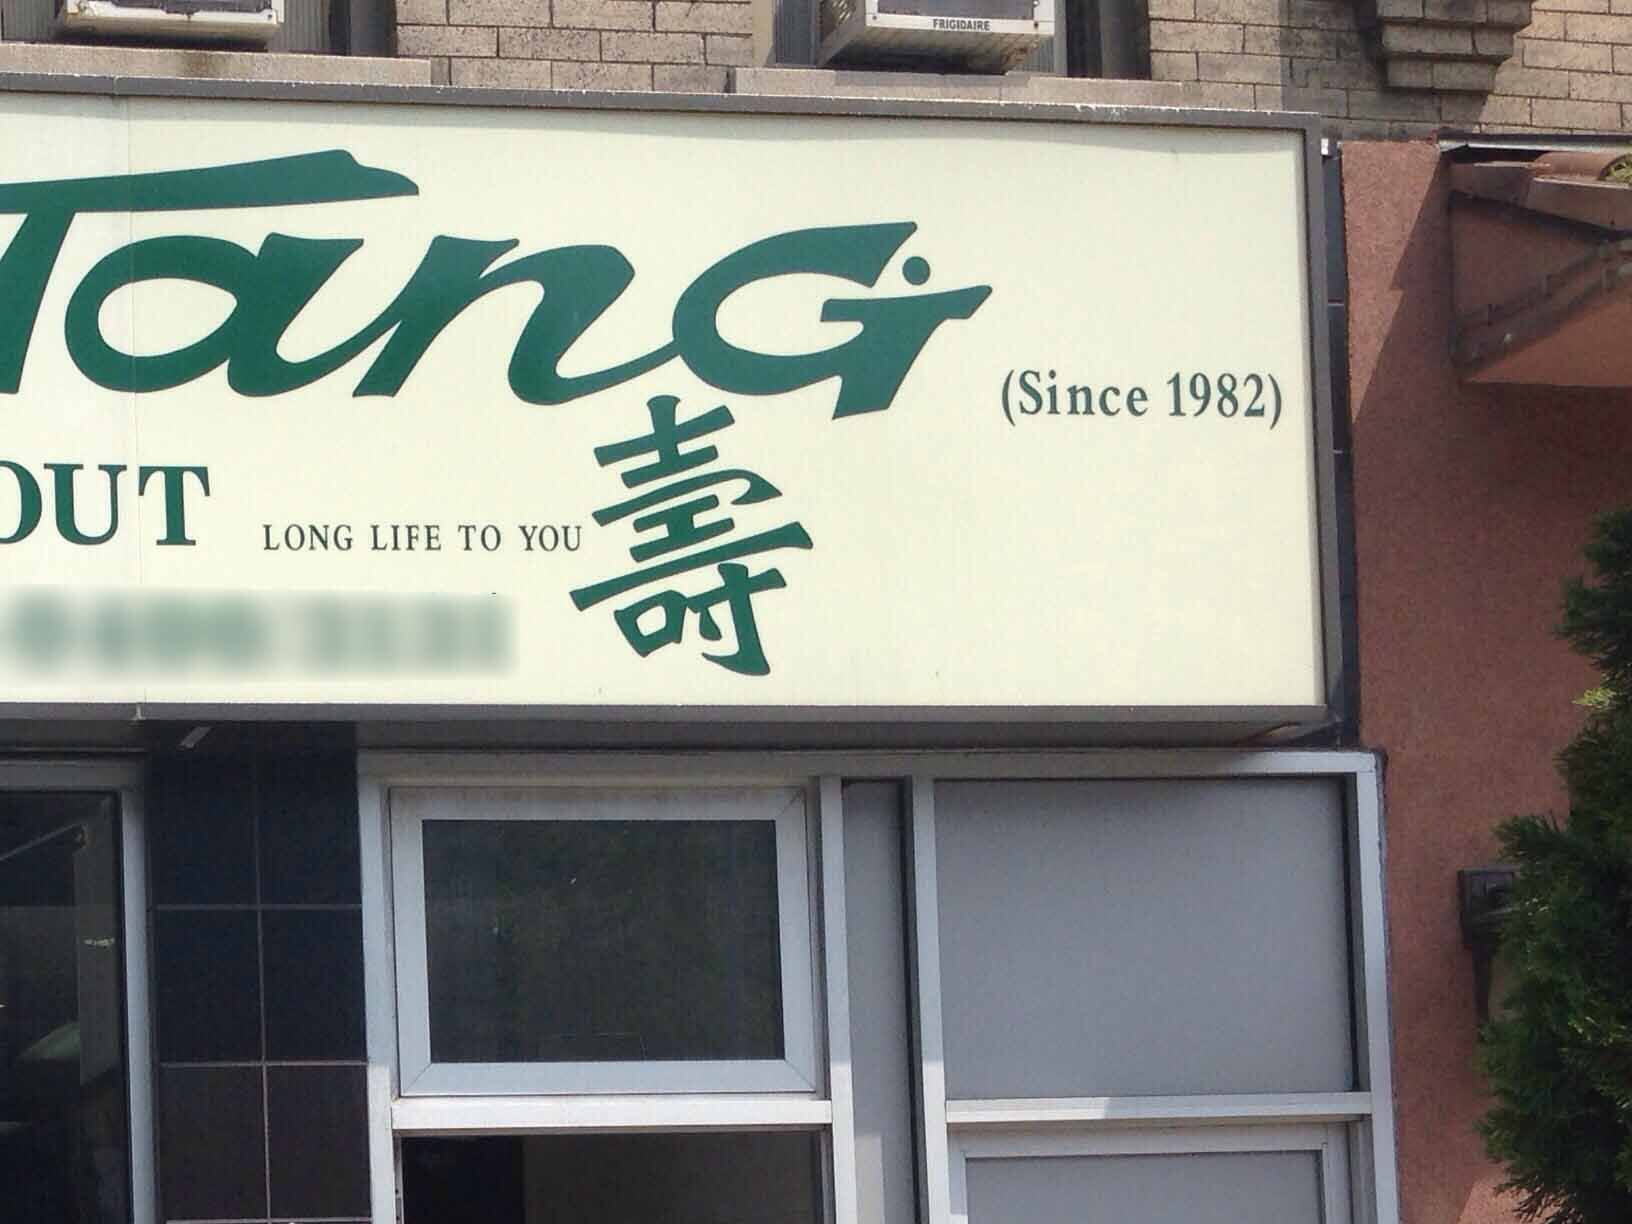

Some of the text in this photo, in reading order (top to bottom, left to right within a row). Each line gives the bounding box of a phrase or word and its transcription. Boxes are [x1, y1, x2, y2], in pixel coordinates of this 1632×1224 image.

[932, 18, 991, 31] FRIGIDAIRE
[1001, 369, 1283, 430] (Since 1982)
[262, 523, 583, 553] LONG LIFE TO YOU
